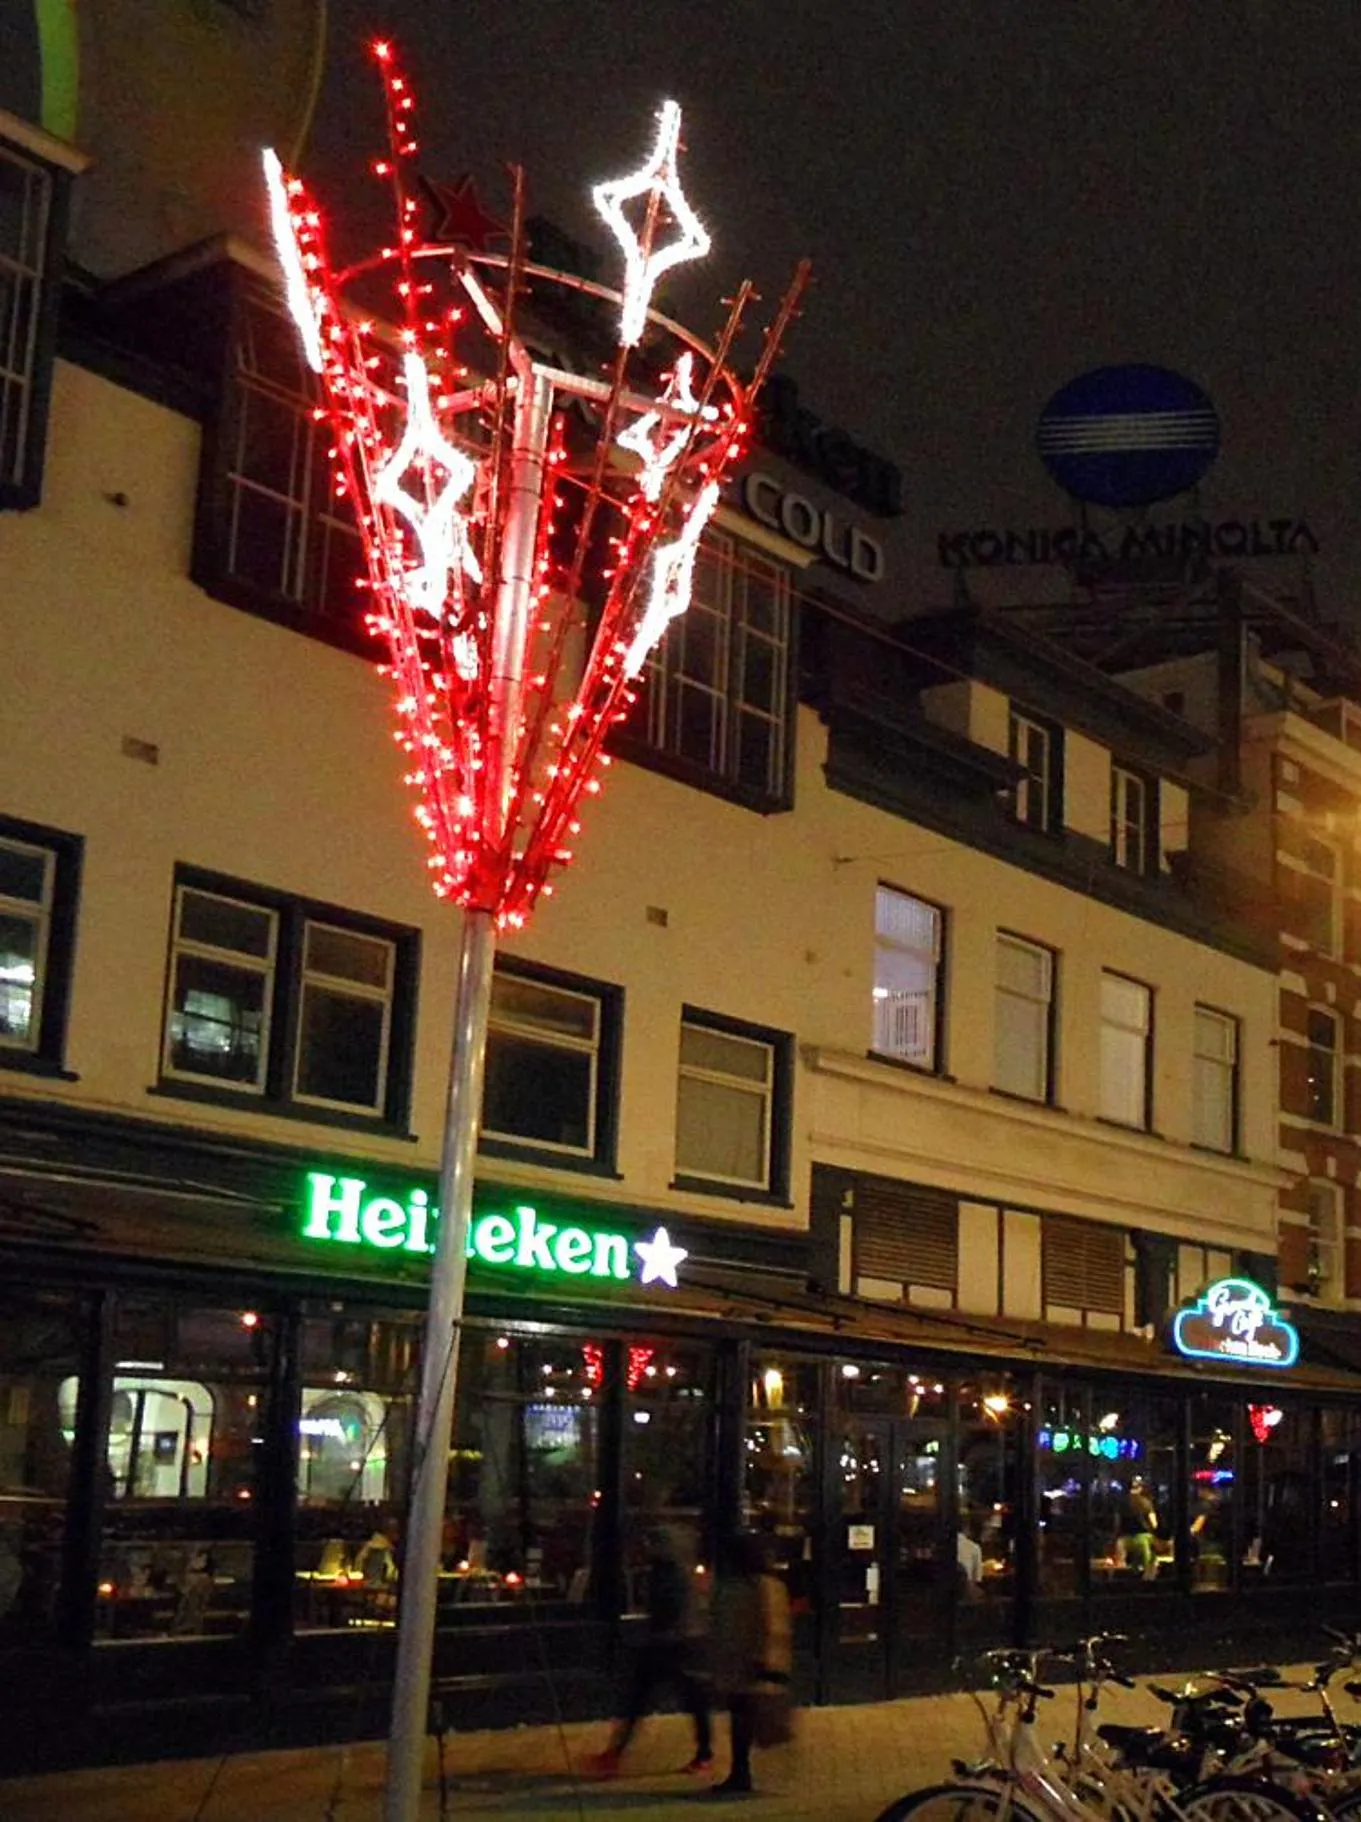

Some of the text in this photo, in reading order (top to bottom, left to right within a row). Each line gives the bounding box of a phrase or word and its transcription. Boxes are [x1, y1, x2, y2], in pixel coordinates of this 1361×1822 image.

[746, 471, 885, 583] COLD
[938, 517, 1321, 567] KONICA MINOLTA
